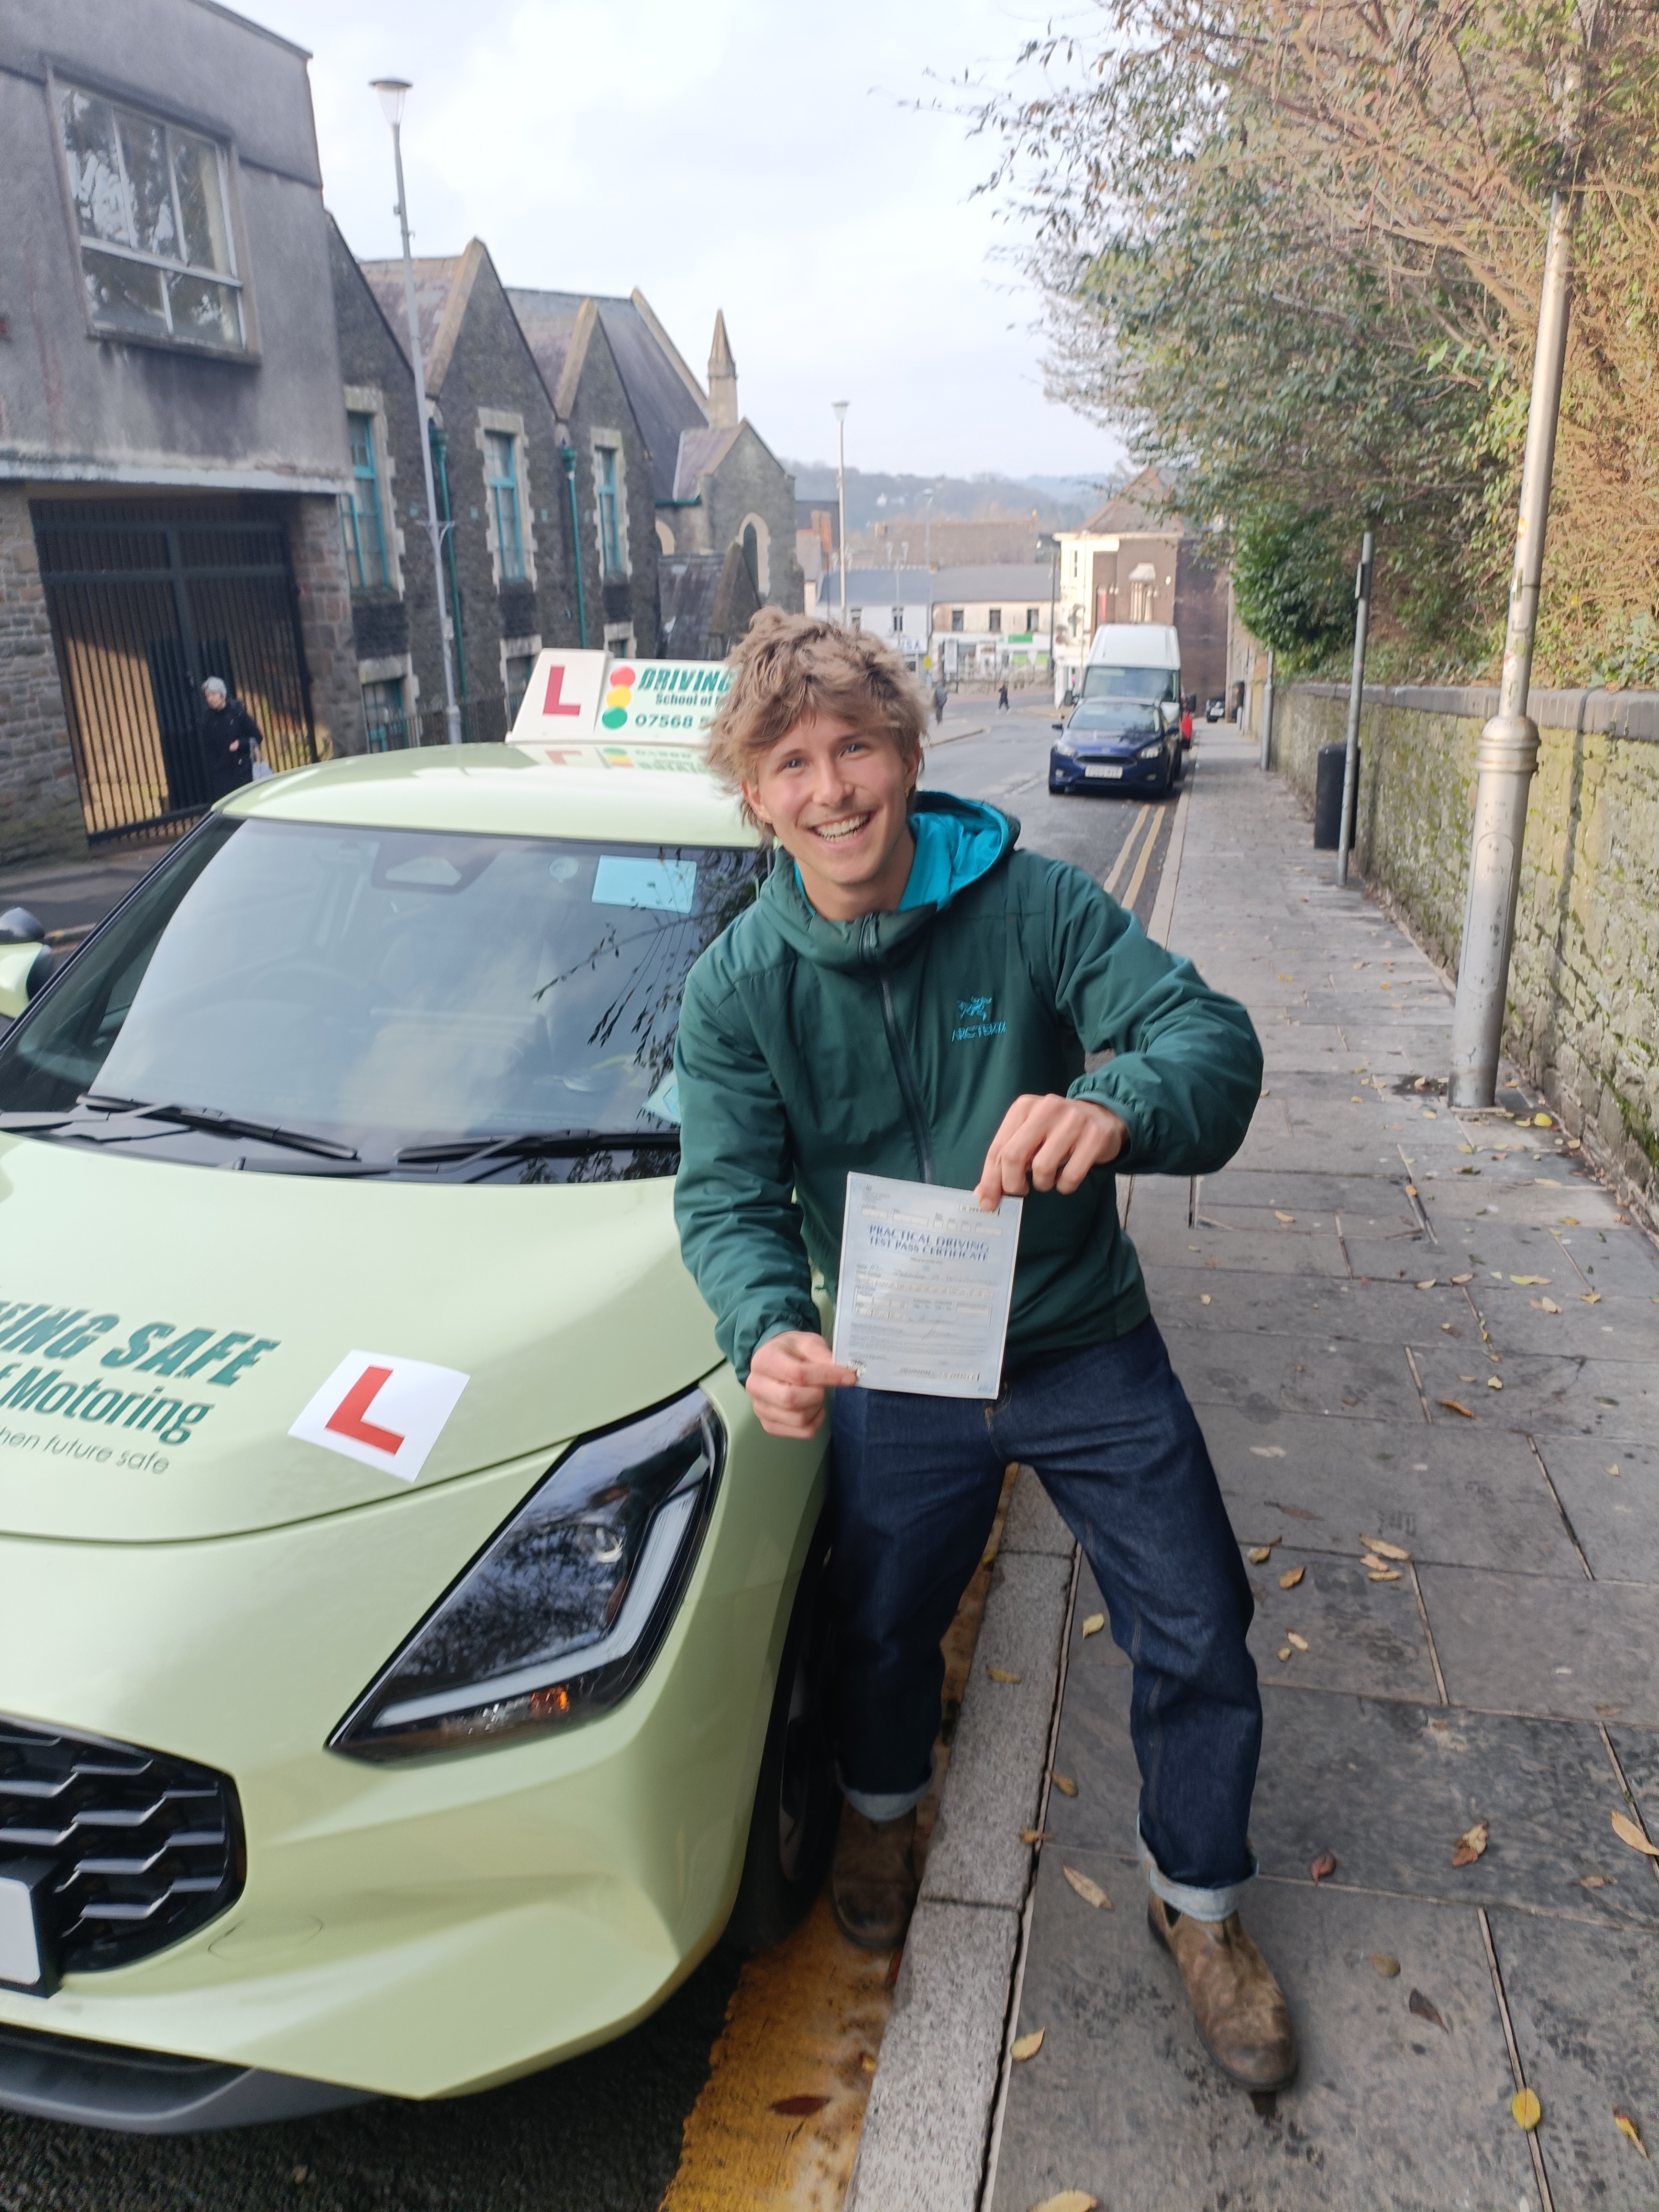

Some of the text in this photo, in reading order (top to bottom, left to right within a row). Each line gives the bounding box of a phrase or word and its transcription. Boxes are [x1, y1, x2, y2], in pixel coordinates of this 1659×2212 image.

[542, 664, 581, 717] L
[638, 667, 735, 692] DRIVING
[655, 693, 697, 706] School
[700, 693, 712, 706] of
[635, 713, 694, 728] 07568
[869, 1224, 990, 1252] PRACTICAL DRIVING
[869, 1235, 891, 1249] TEST
[895, 1239, 919, 1253] PASS
[922, 1245, 989, 1261] CERTIFICATE
[100, 1321, 282, 1388] SAFE
[0, 1366, 215, 1446] Motoring
[324, 1364, 406, 1457] L
[43, 1434, 113, 1462] future
[116, 1450, 169, 1474] safe
